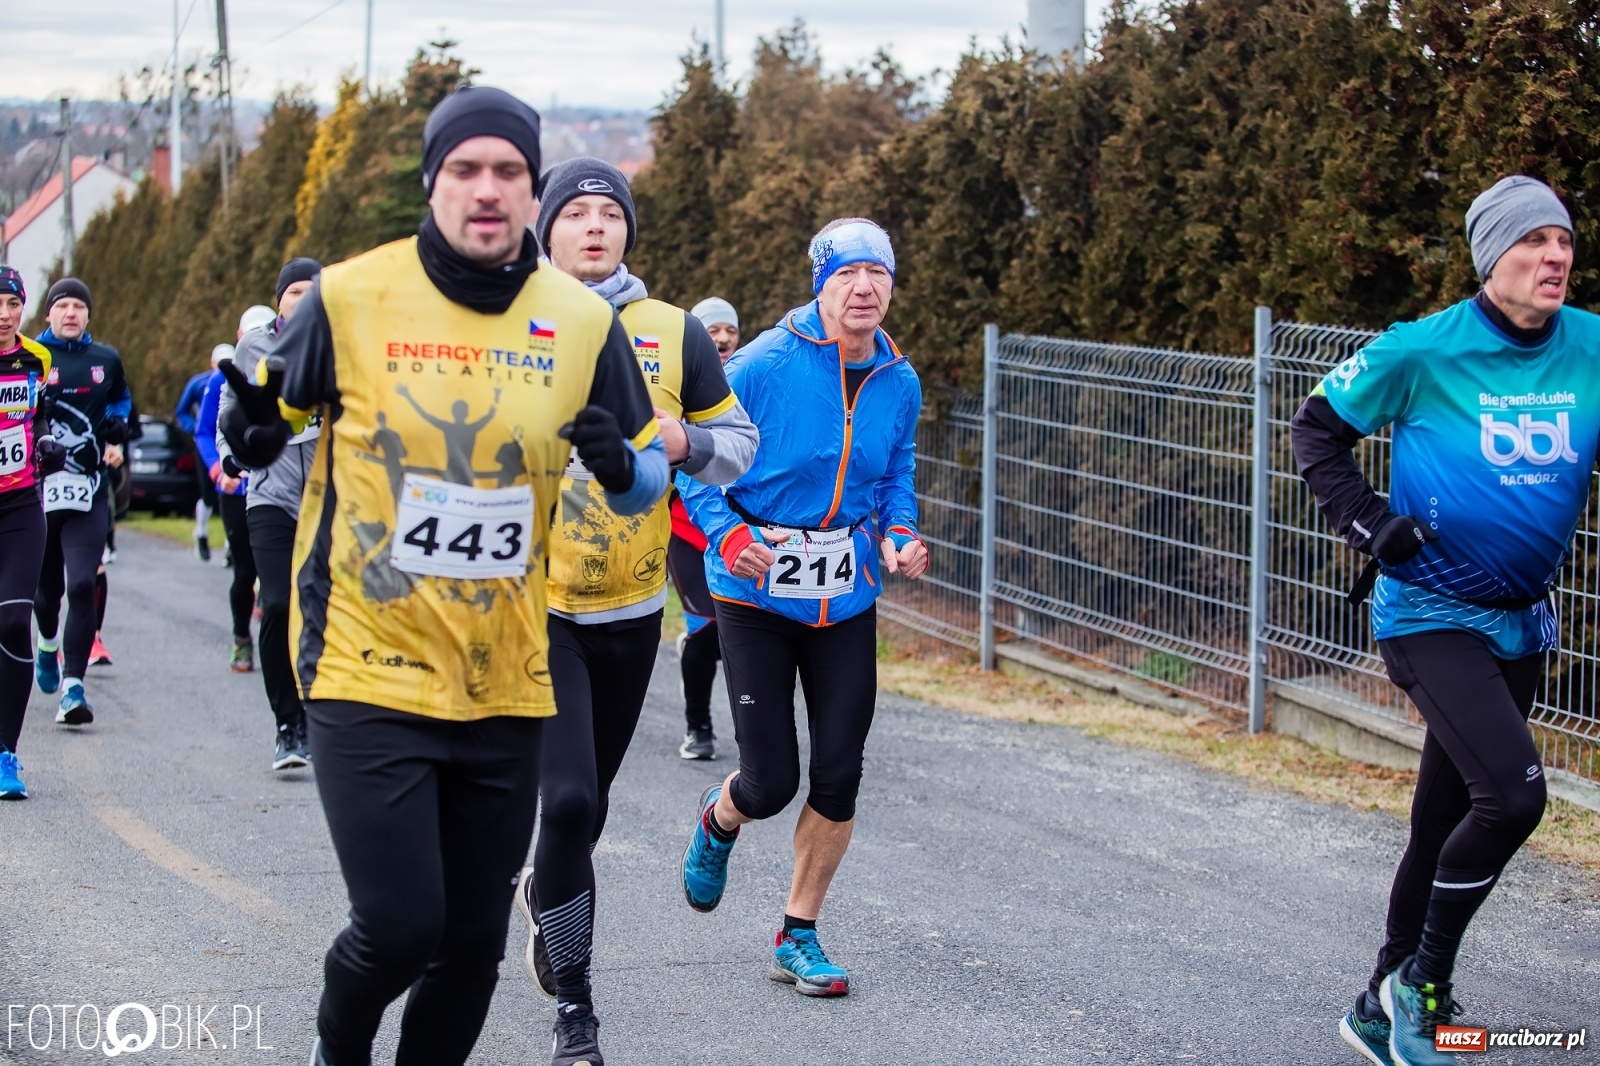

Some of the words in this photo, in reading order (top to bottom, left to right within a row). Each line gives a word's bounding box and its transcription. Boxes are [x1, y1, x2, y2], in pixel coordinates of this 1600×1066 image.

[387, 342, 484, 363] ENERGY
[493, 349, 554, 372] TEAM
[387, 361, 553, 388] BOLATICE
[1480, 411, 1579, 467] bbl
[47, 485, 90, 503] 352
[1499, 472, 1559, 486] RACIBÓRZ
[403, 516, 523, 561] 443
[775, 552, 853, 586] 214
